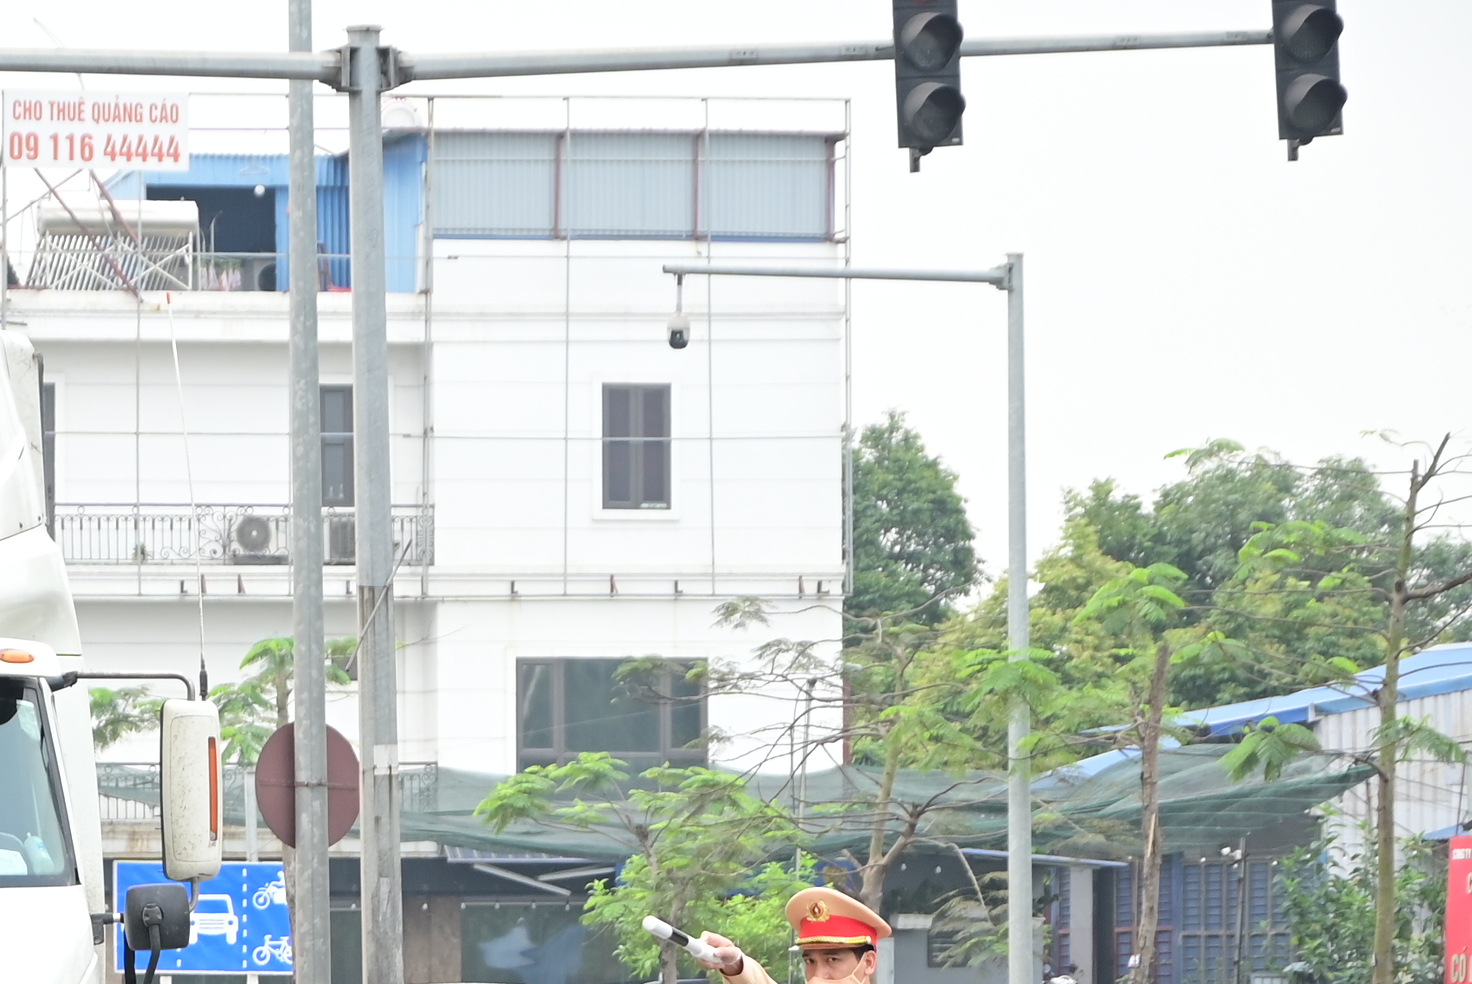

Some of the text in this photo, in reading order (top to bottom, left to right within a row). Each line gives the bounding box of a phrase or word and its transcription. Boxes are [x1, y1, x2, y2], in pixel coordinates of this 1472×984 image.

[12, 94, 180, 125] CHO THUÊ QUẢNG CÁO
[9, 131, 181, 163] 09 116 44444
